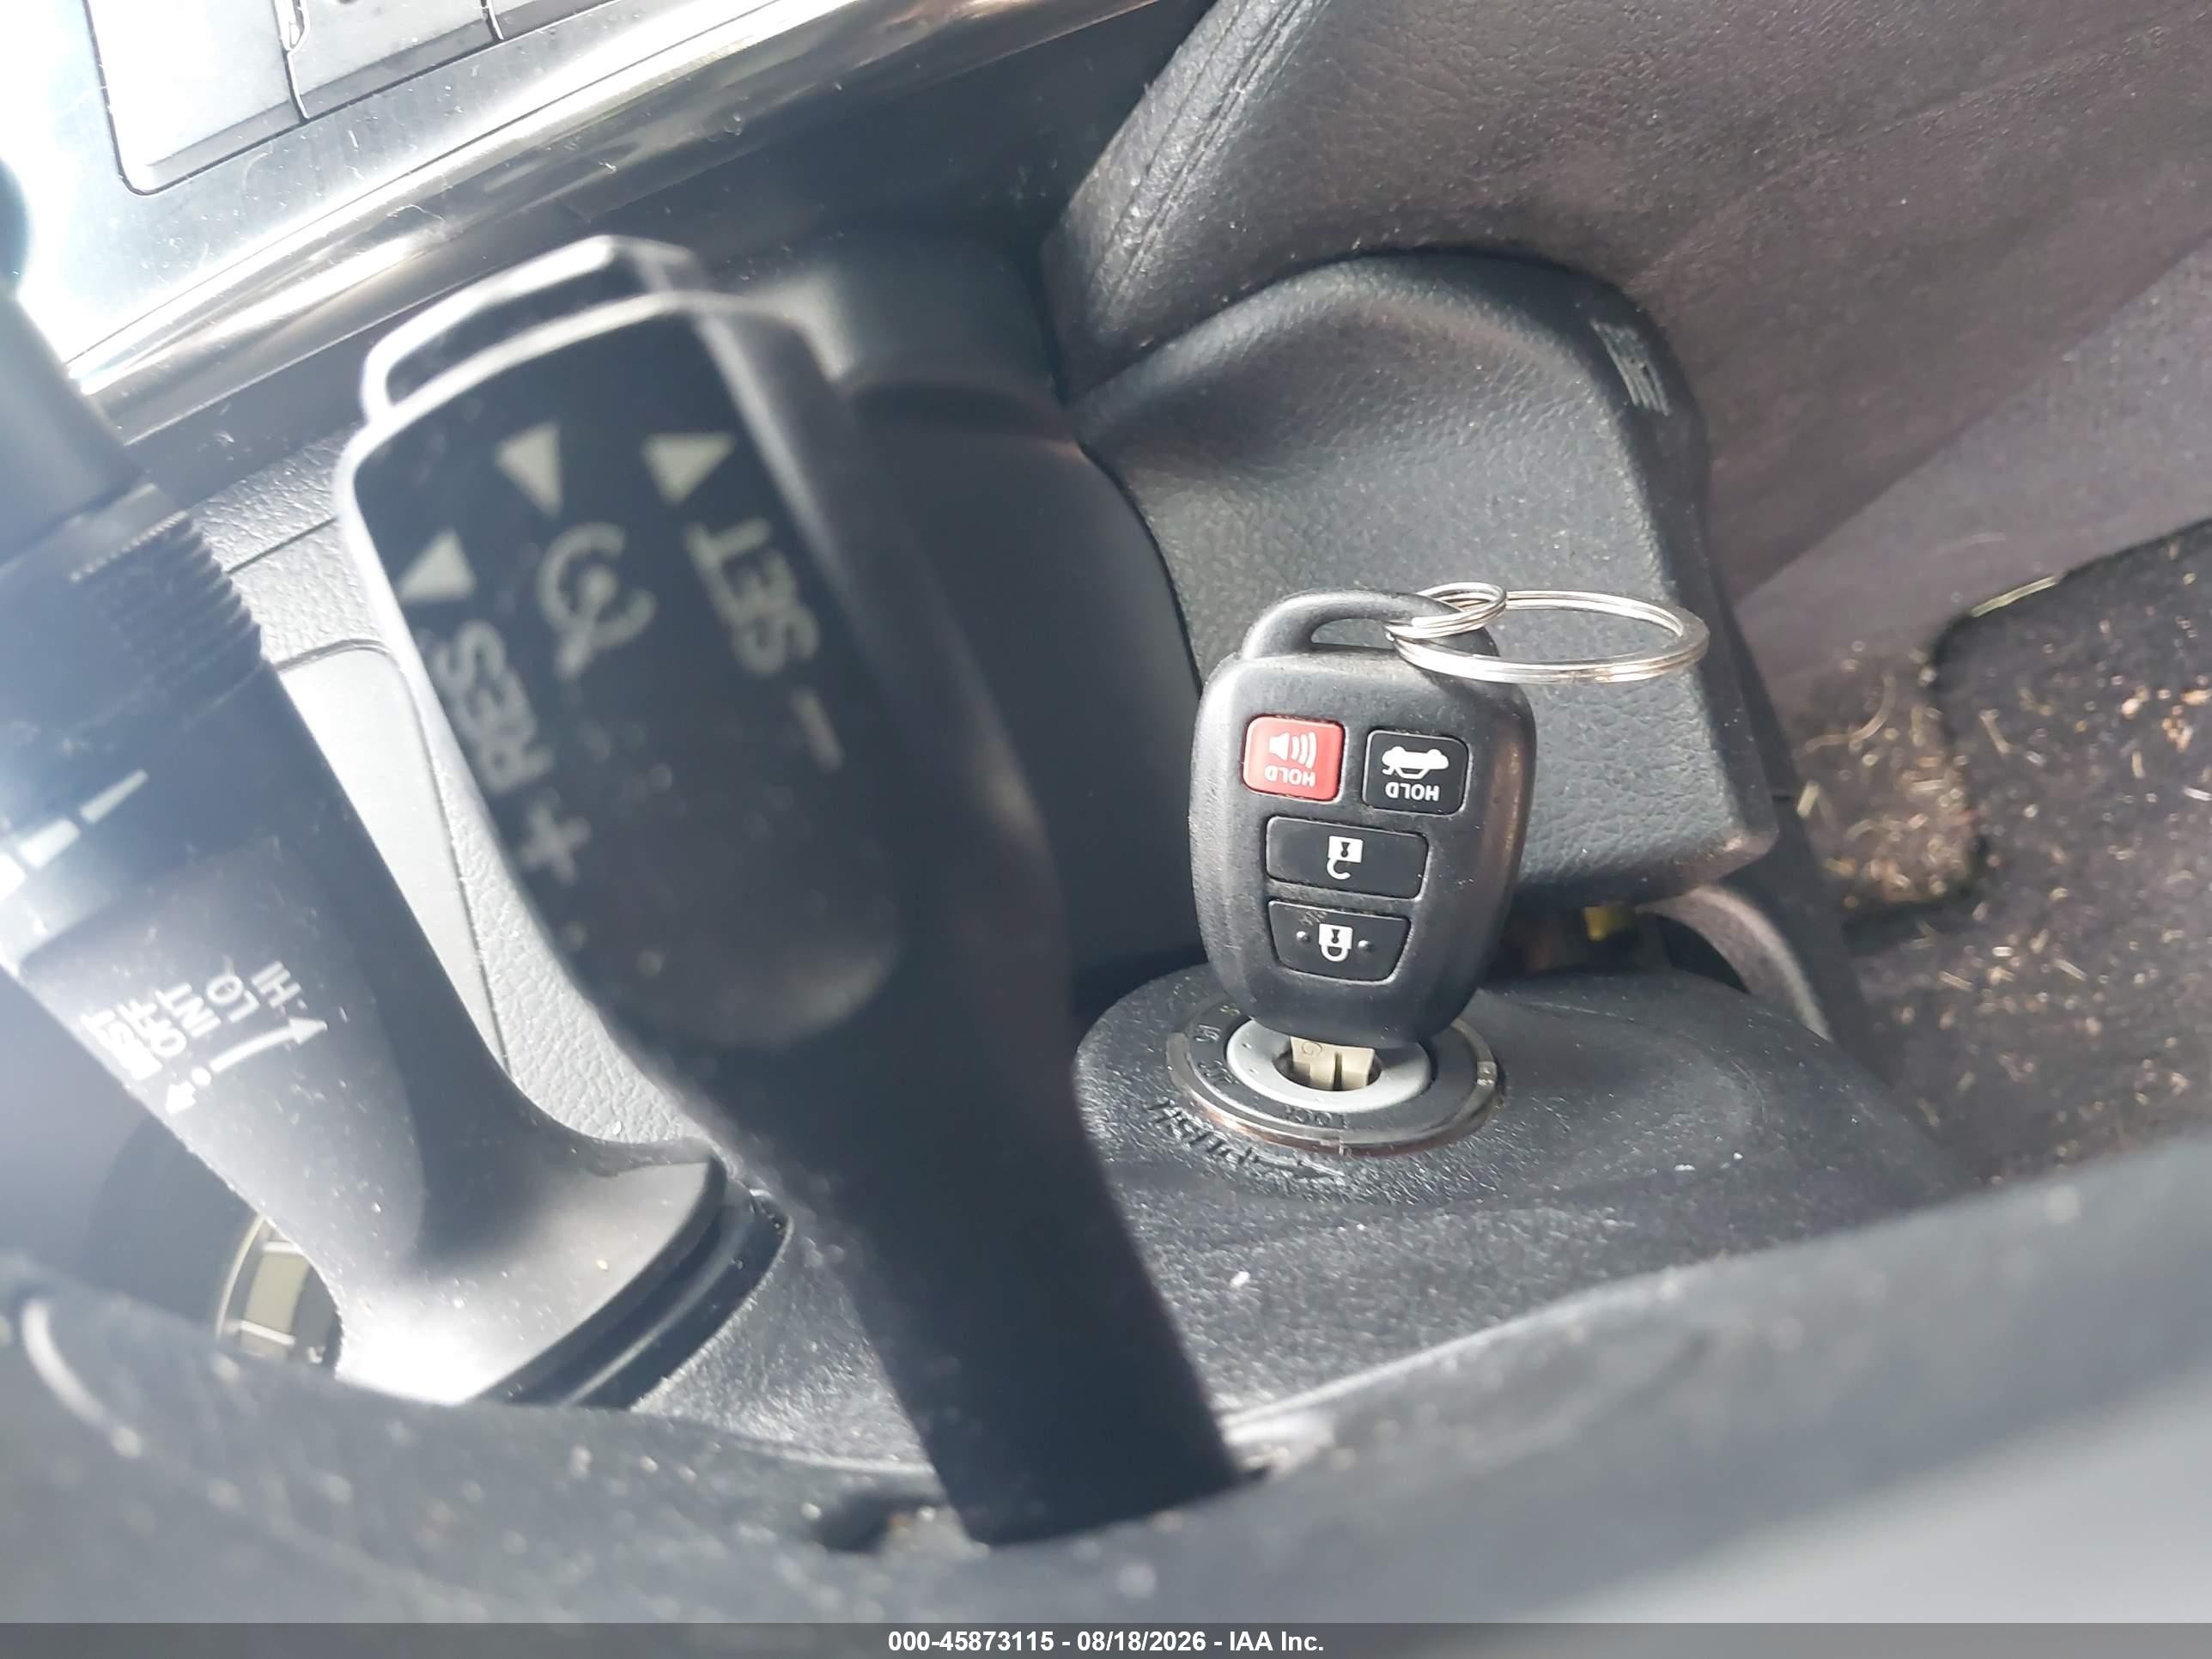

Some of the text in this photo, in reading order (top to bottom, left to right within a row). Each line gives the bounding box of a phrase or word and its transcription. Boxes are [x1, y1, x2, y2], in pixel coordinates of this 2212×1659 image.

[684, 515, 818, 674] SET
[434, 620, 554, 795] RES
[1264, 765, 1316, 787] HOLD
[1384, 781, 1440, 802] HOLD
[155, 982, 221, 1037] INT
[206, 975, 259, 1023] LO
[251, 961, 301, 1009] HI
[79, 1009, 163, 1080] ST
[116, 1000, 186, 1058] OFF
[1148, 1098, 1255, 1163] PUSH
